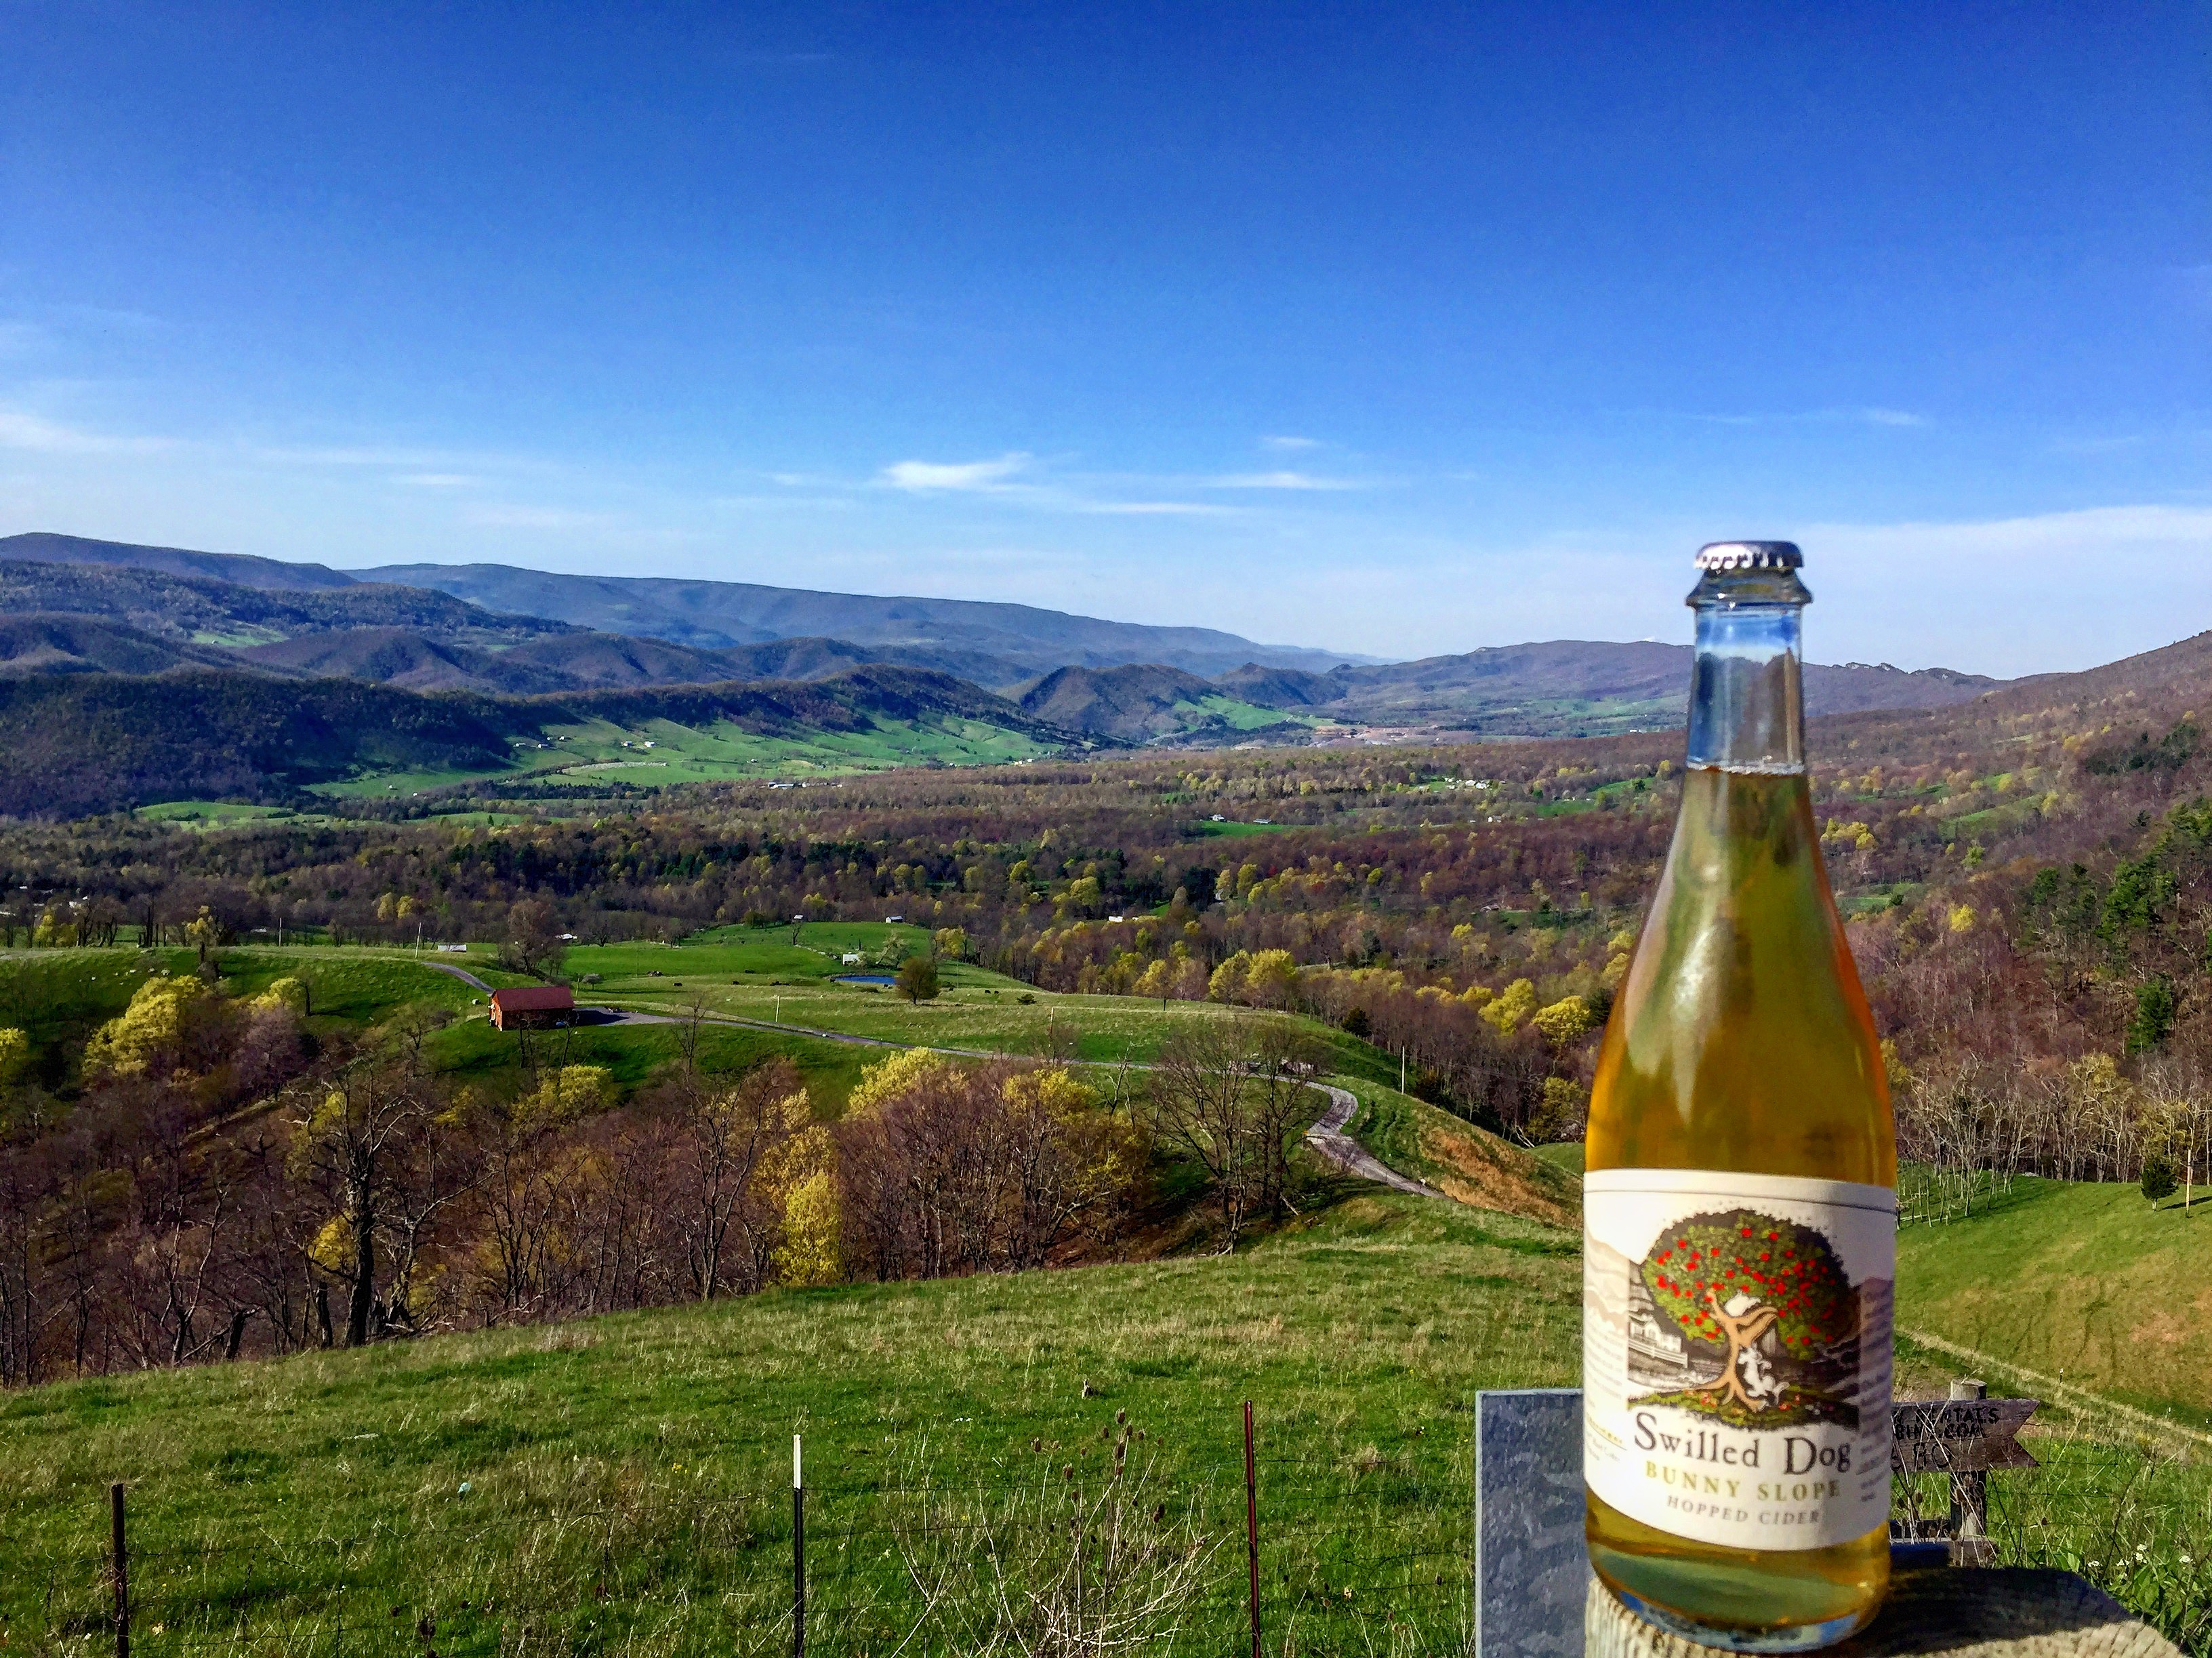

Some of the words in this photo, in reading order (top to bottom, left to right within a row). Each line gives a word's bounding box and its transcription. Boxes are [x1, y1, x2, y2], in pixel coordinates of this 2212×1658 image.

[1634, 1412, 1761, 1468] Swilled
[1783, 1436, 1851, 1476] Dog
[1645, 1460, 1740, 1498] BUNNY
[1757, 1479, 1841, 1502] SLOPE
[1666, 1495, 1748, 1522] HOPPED
[1758, 1509, 1820, 1525] CIDER
